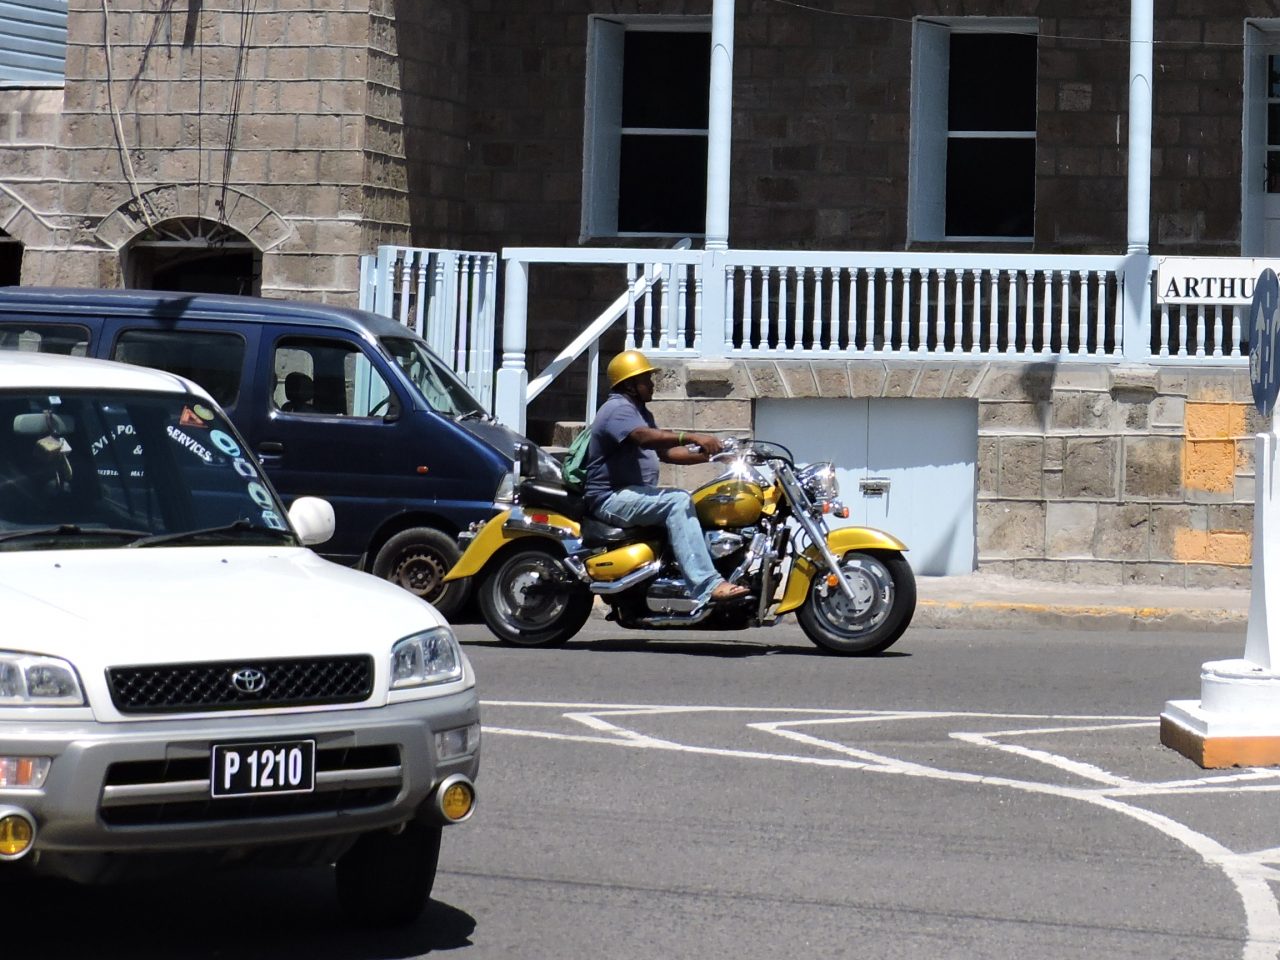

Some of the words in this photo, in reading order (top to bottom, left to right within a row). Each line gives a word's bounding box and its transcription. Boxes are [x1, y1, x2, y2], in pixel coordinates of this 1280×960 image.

[1164, 276, 1256, 299] ARTHU
[166, 425, 213, 462] SERVICES
[224, 751, 241, 790] P
[247, 748, 303, 788] 1210
